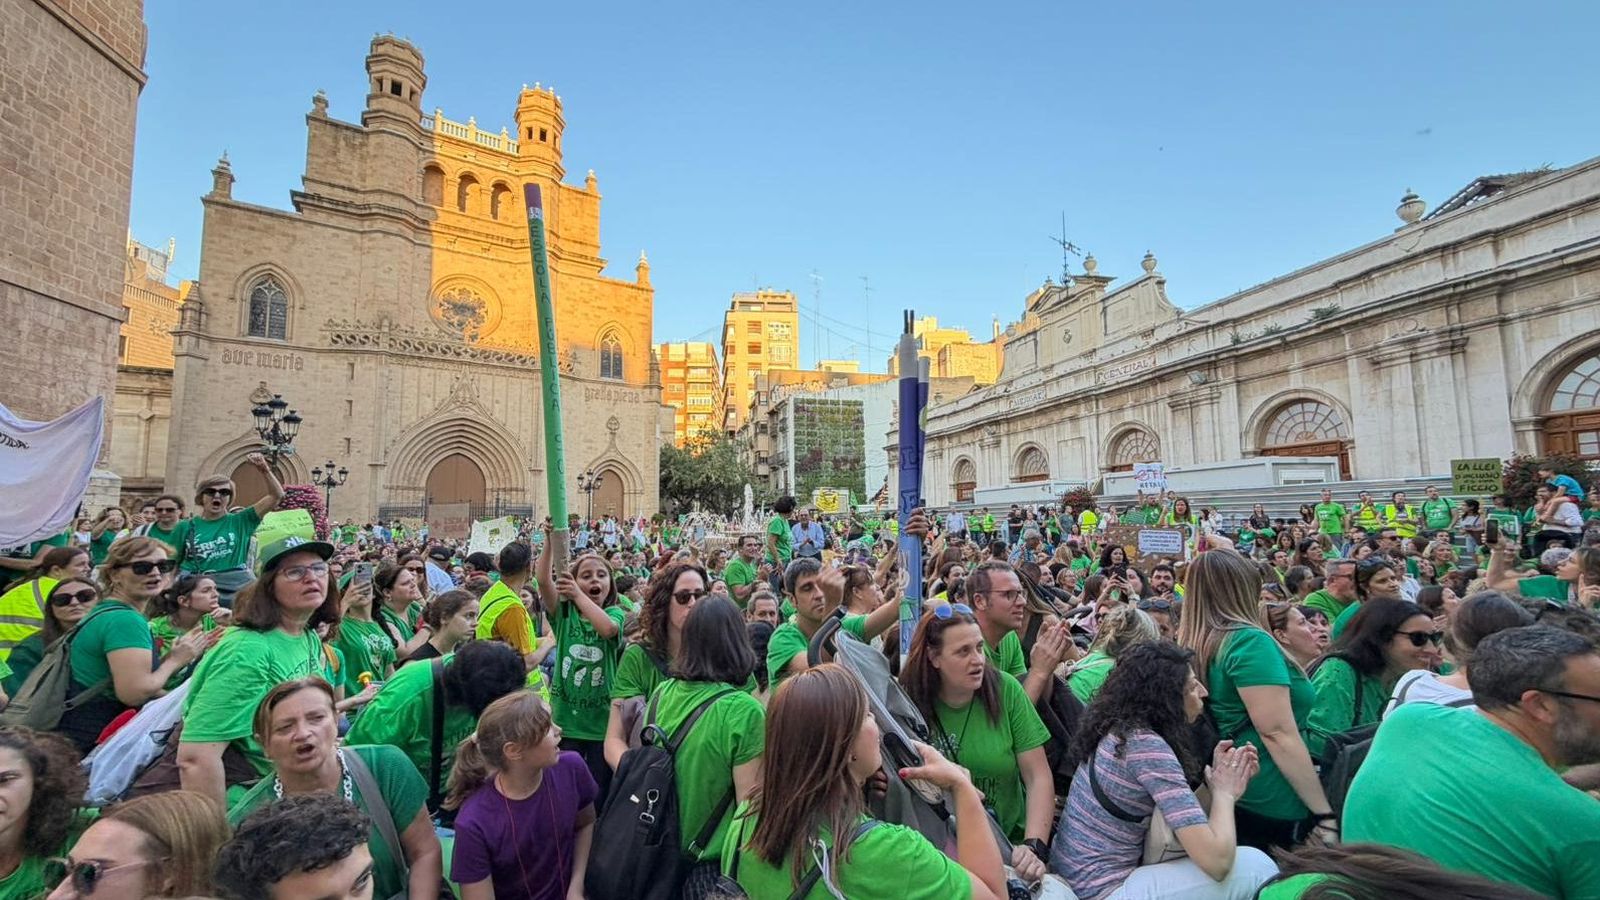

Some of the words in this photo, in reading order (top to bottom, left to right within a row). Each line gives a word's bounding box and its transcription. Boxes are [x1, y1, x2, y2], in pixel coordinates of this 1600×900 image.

[531, 225, 551, 305] ESCOLA
[256, 352, 304, 371] maria
[1103, 360, 1150, 380] CENTRAL
[1457, 463, 1470, 471] LA
[1472, 463, 1495, 471] LLEI
